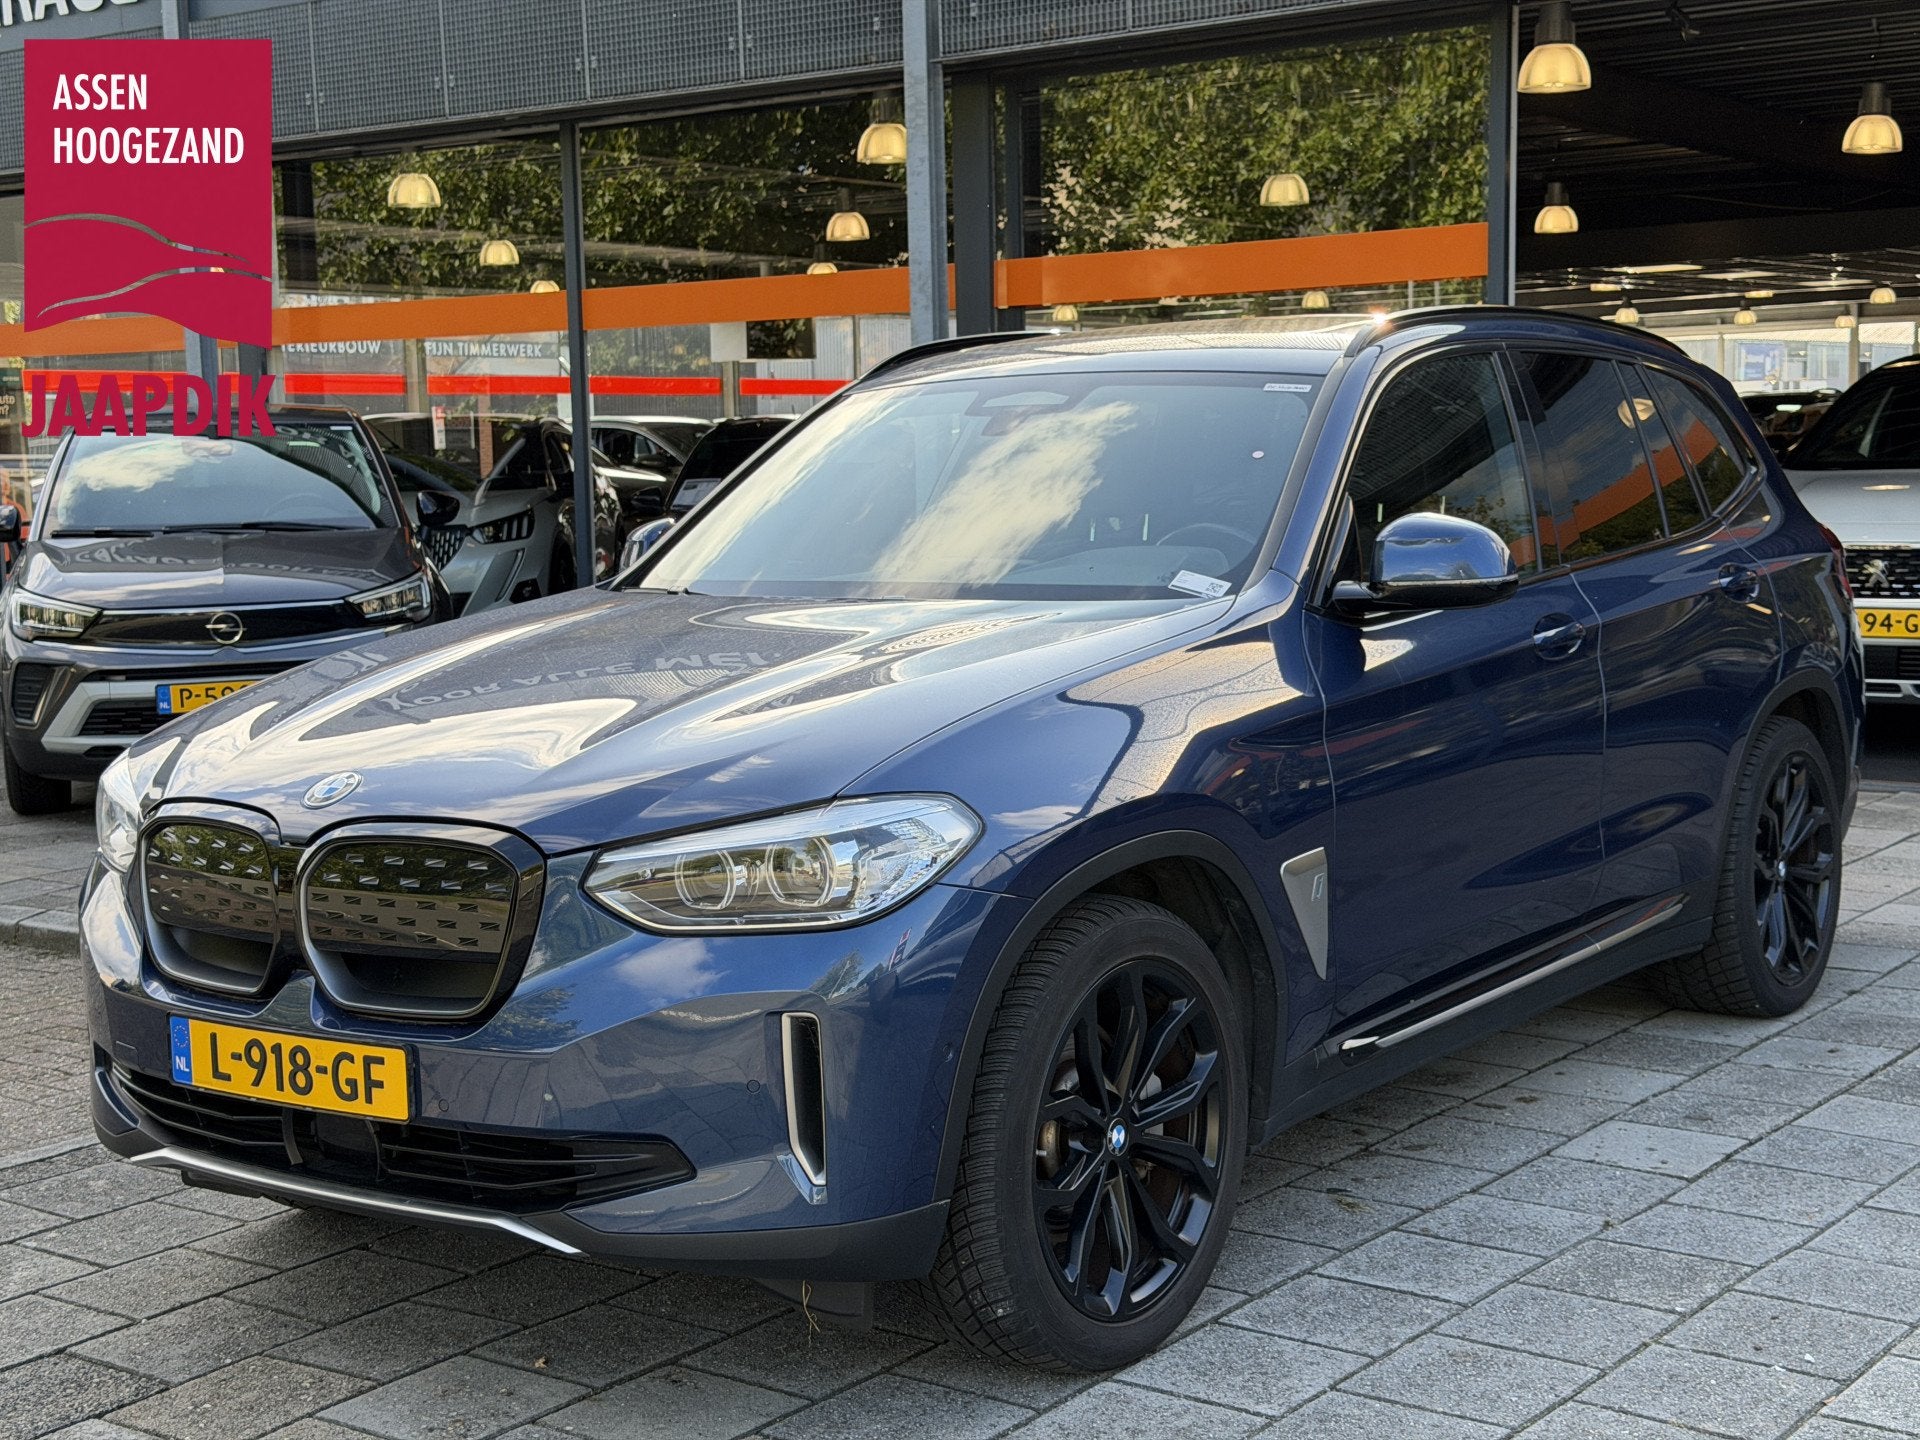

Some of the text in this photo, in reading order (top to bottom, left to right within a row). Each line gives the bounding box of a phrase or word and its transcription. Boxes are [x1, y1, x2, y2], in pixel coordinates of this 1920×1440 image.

[458, 341, 542, 357] TIMMERWERK
[160, 701, 170, 709] NL
[175, 1056, 190, 1073] NL
[210, 1031, 385, 1105] L-918-GF
